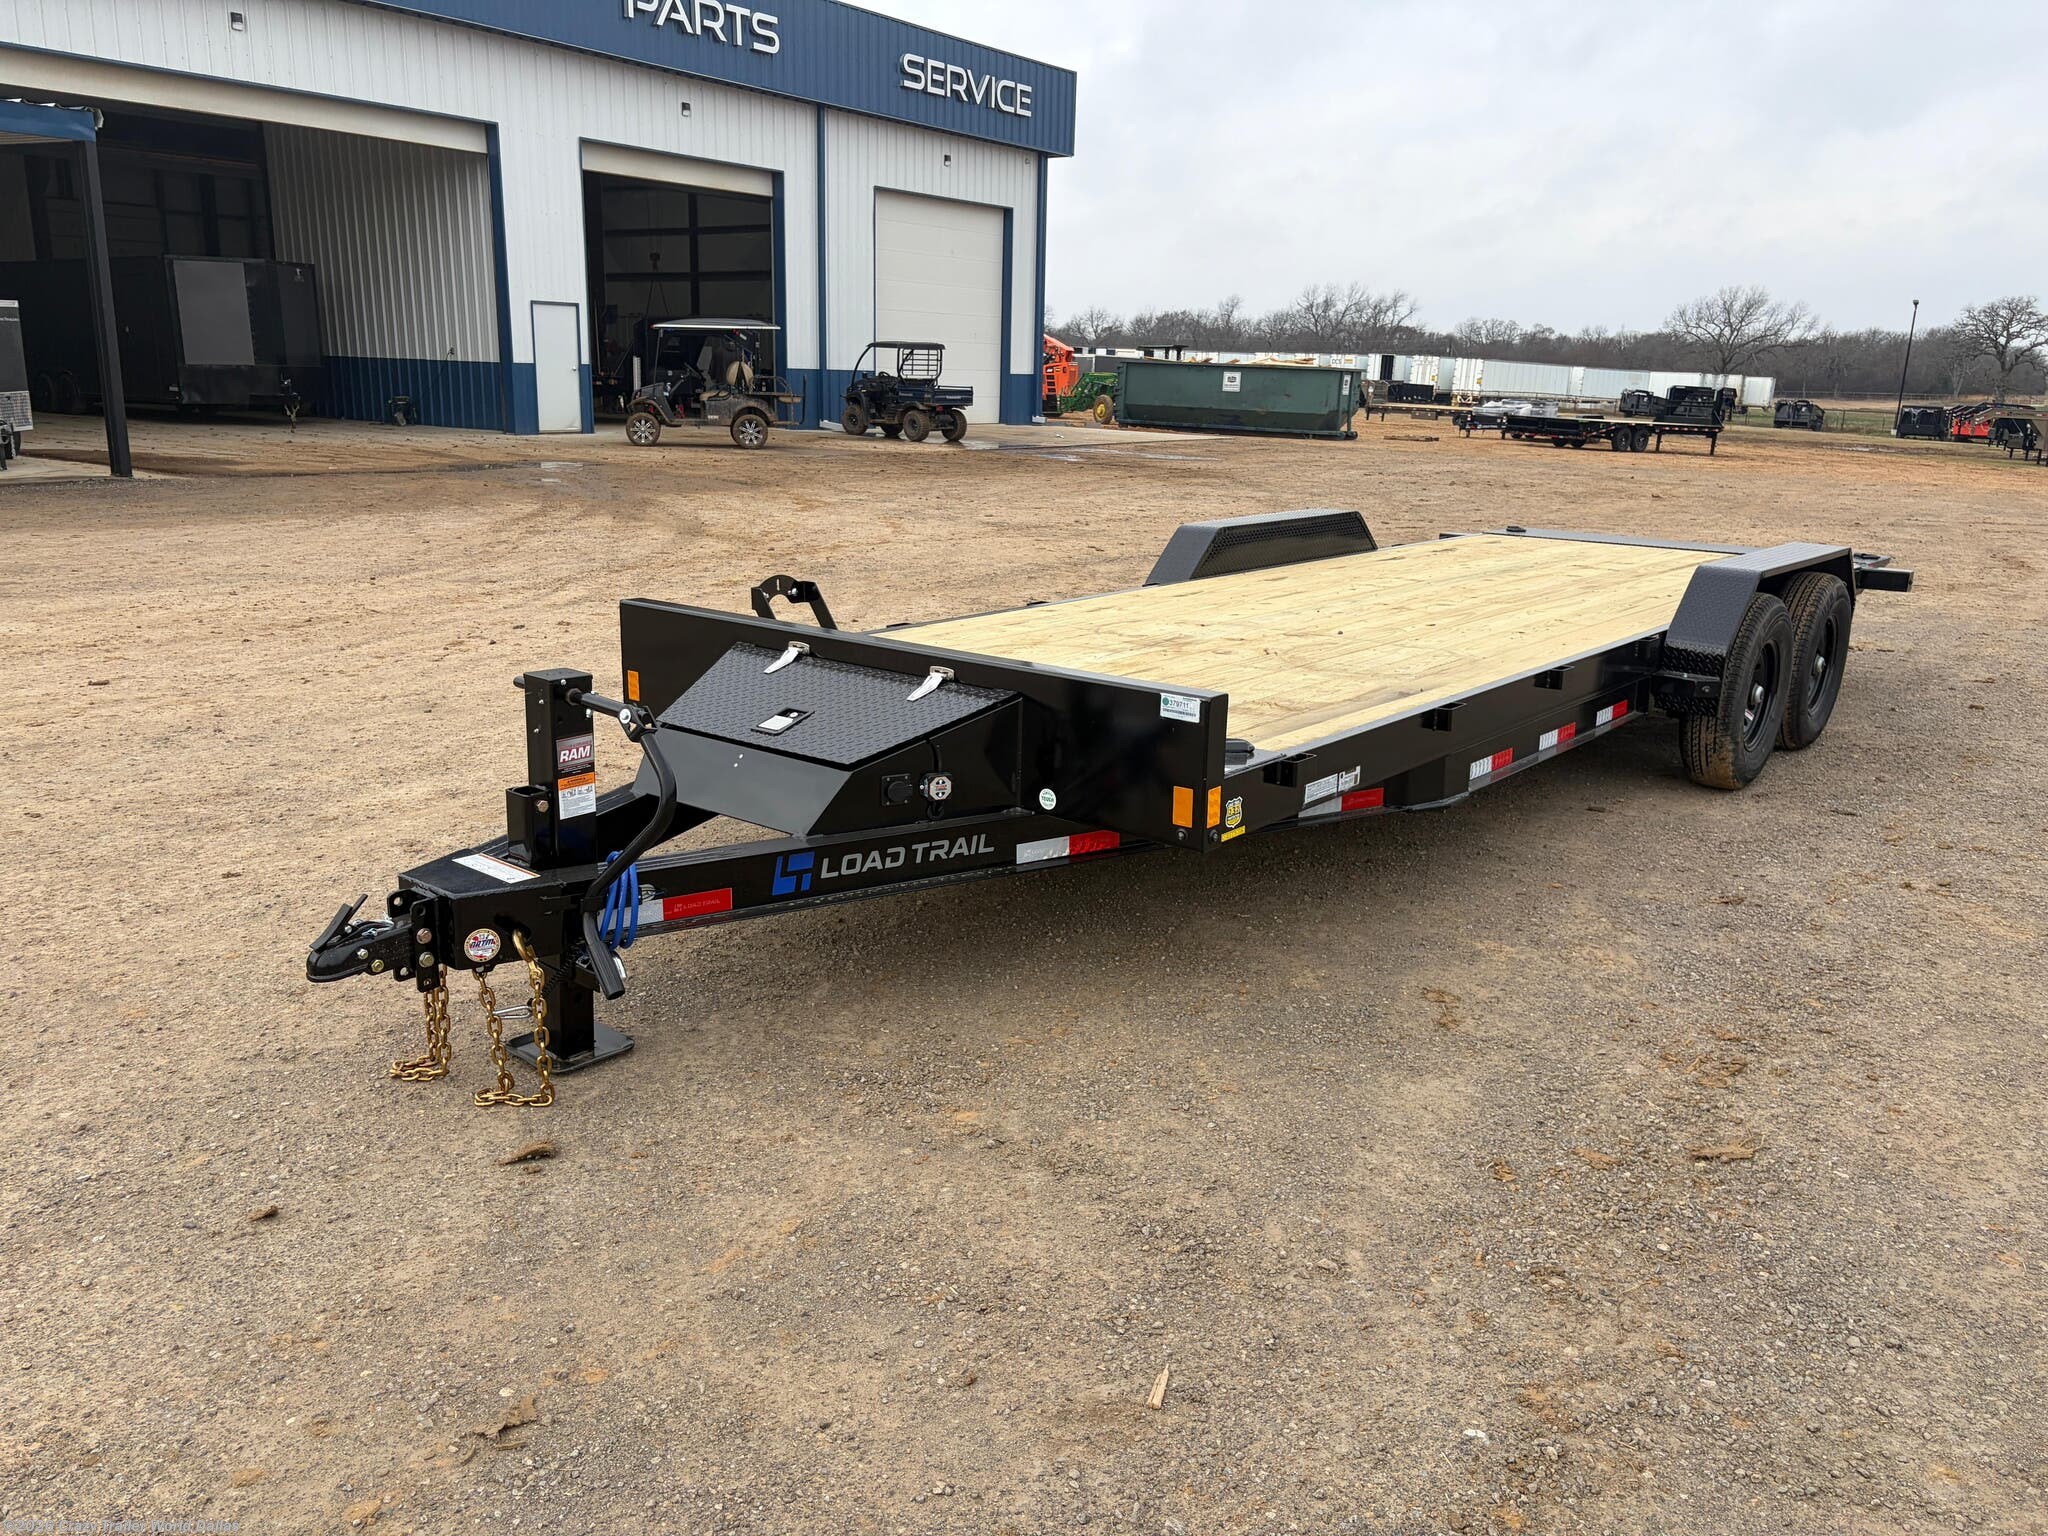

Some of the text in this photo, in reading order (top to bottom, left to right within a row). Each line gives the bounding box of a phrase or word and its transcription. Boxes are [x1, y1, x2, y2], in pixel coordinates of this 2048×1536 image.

[902, 53, 1032, 118] SERVICE
[560, 745, 591, 762] RAM
[820, 847, 906, 879] LOAD
[911, 833, 995, 864] TRAIL
